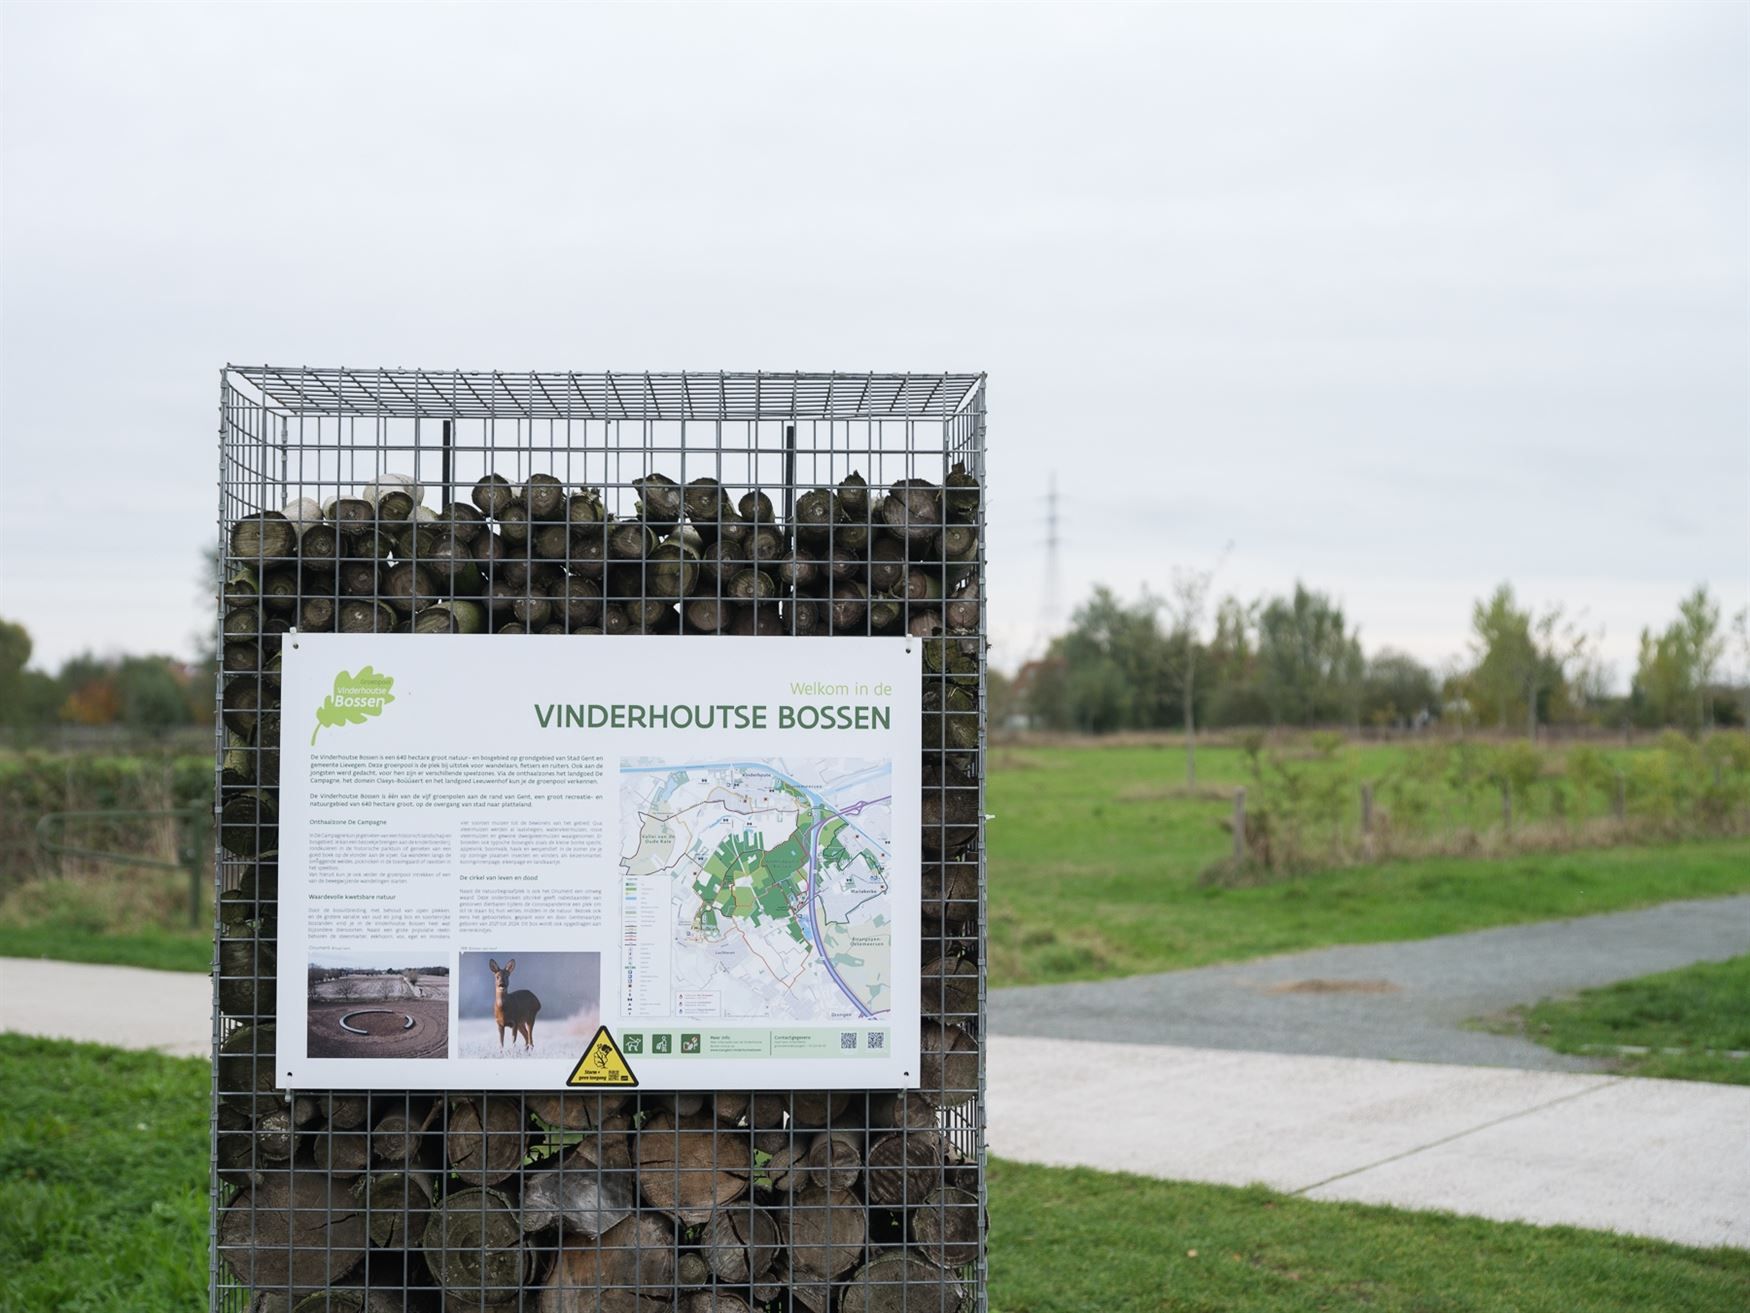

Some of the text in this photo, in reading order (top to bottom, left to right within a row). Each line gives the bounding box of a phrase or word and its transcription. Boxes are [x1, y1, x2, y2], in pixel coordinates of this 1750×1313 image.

[790, 682, 892, 696] Welkom in de
[335, 695, 385, 707] Bossen
[534, 704, 891, 730] VINDERHOUTSE BOSSEN
